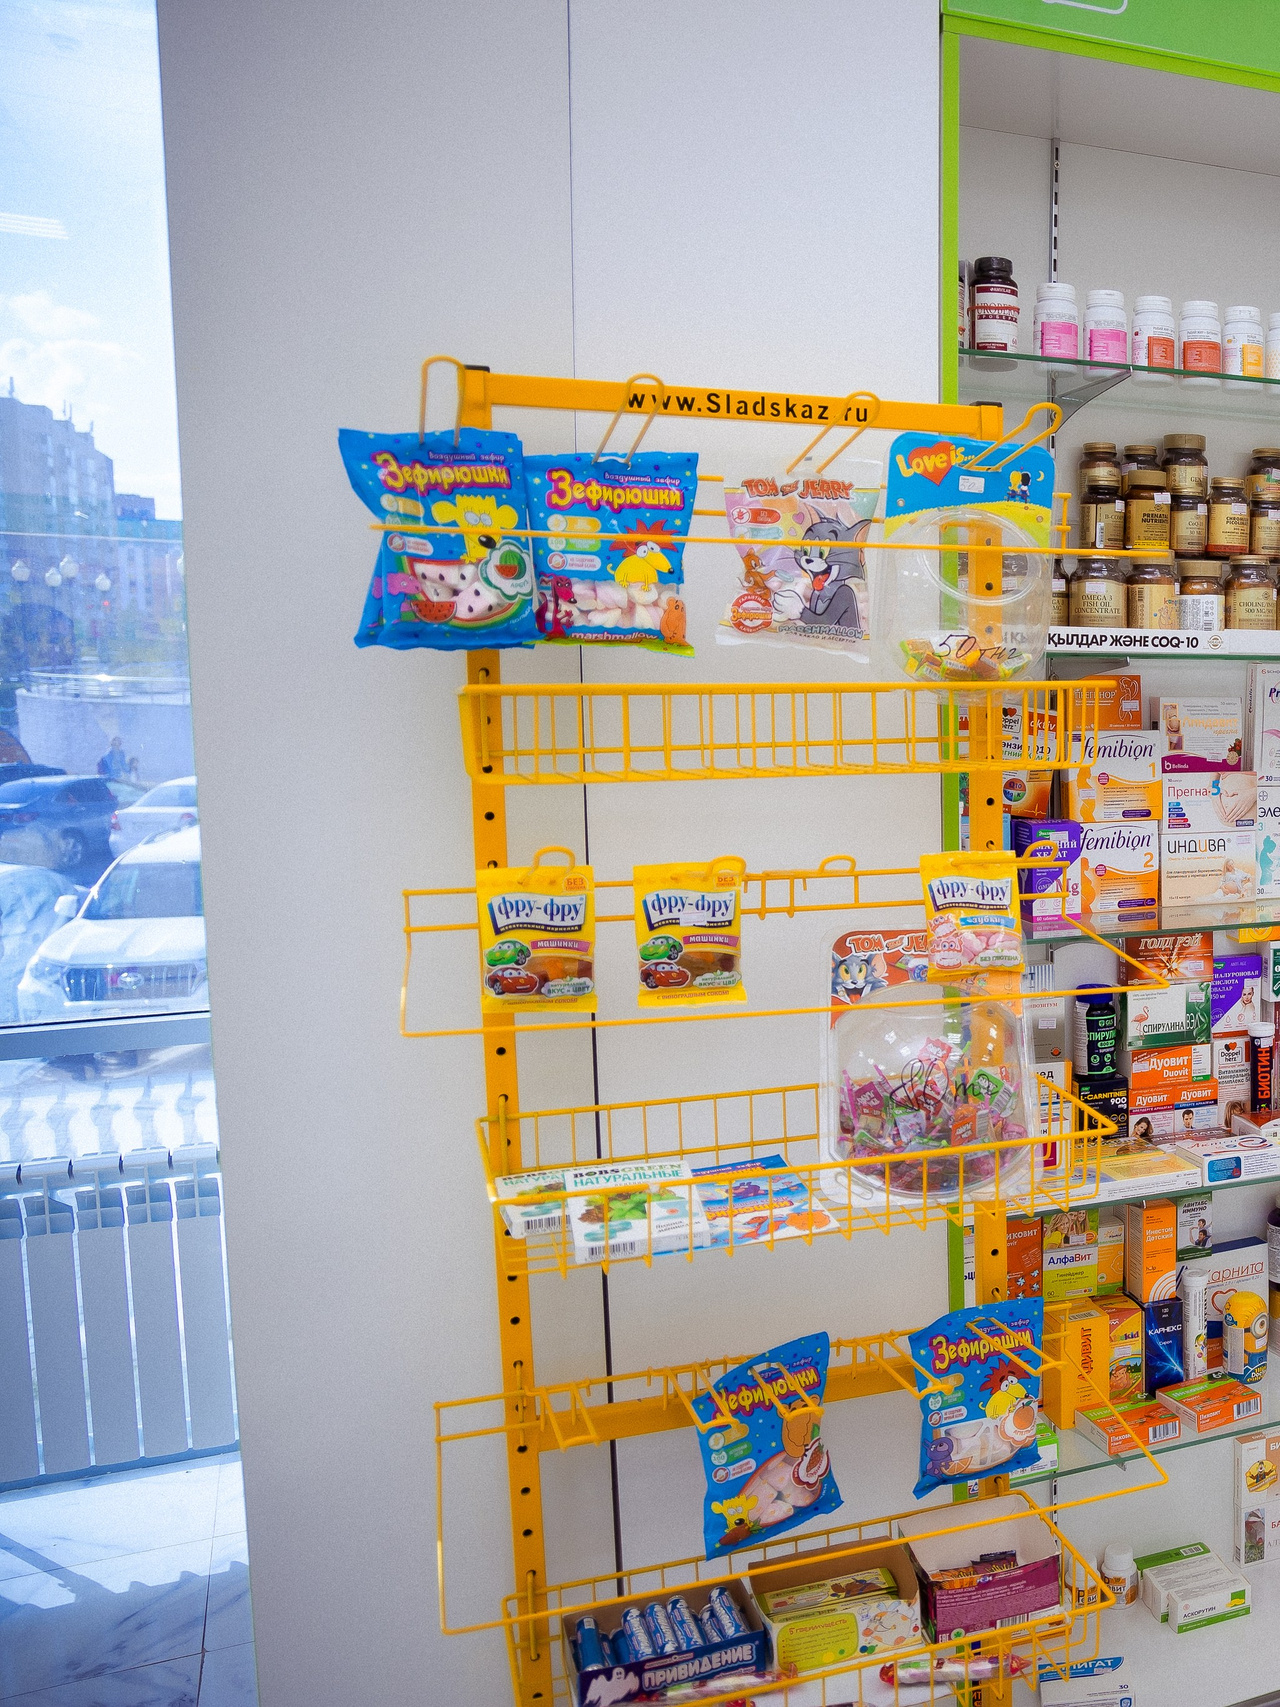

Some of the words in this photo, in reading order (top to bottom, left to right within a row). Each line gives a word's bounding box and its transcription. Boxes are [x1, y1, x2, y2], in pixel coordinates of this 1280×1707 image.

[895, 448, 948, 478] Love
[376, 453, 509, 492] Зефирюшки
[552, 470, 682, 509] Зефирюшки
[743, 477, 778, 497] TOM
[799, 479, 855, 499] JERRY
[571, 630, 658, 642] marshmallow
[778, 625, 864, 640] MARSHMALLOW
[1110, 635, 1149, 648] ЖӘНЕ
[1151, 636, 1199, 649] COQ-10
[1084, 736, 1153, 761] femibion
[1080, 828, 1151, 851] femibion
[1144, 852, 1154, 868] 2
[567, 878, 584, 886] БЕЗ
[937, 880, 1009, 901] фру-фру
[498, 897, 583, 921] фру-фру
[651, 893, 733, 917] фру-фру
[972, 916, 1001, 925] зубки
[537, 941, 579, 949] машинки
[689, 935, 729, 943] машинки
[850, 937, 885, 953] TOM
[1139, 937, 1173, 950] ГОЛД
[1176, 933, 1202, 946] РЭЙ
[1143, 1022, 1184, 1034] СПИРУЛИНА
[1150, 1056, 1188, 1070] Дуовит
[1164, 1068, 1188, 1078] Duovit
[1258, 1046, 1270, 1099] БИОТИН
[1110, 1097, 1126, 1105] 900
[1136, 1094, 1168, 1106] Дуовит
[1181, 1089, 1212, 1100] Дуовит
[573, 1168, 684, 1188] НАТУРАЛЬНЫЕ
[1182, 1206, 1207, 1214] ИММУНО
[1048, 1252, 1092, 1266] АлфаВит
[1148, 1324, 1182, 1336] КАРНЕКС
[1183, 1606, 1216, 1619] АСКОРУТИН
[643, 1644, 753, 1689] ПРИВИДЕНИЕ
